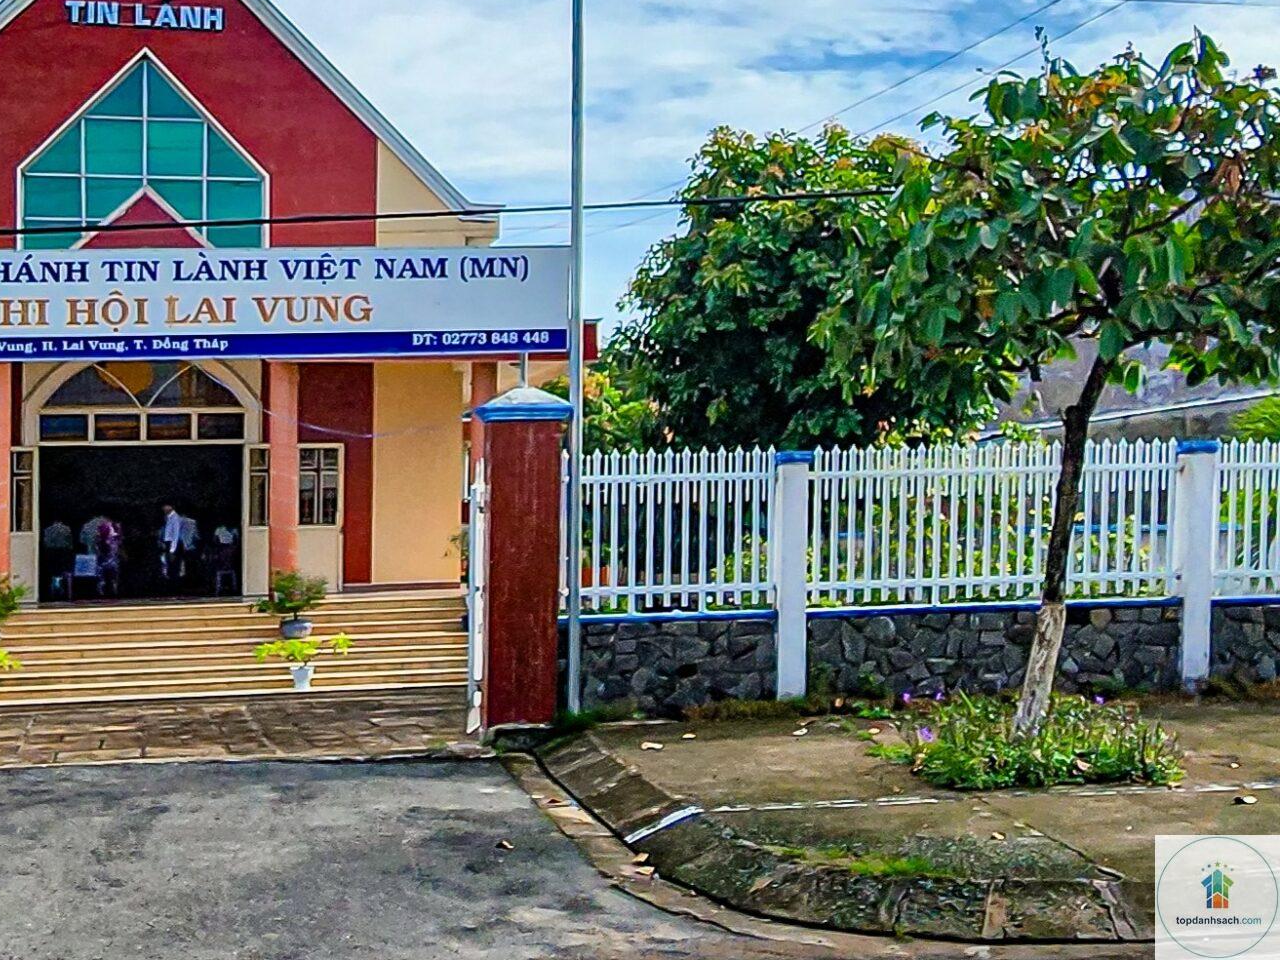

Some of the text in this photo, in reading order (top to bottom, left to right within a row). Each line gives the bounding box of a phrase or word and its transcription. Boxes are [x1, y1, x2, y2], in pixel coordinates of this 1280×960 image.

[65, 0, 119, 25] TIN
[100, 259, 161, 283] TIN
[172, 252, 266, 282] LÀNH
[279, 253, 361, 286] VIỆT
[374, 257, 449, 280] NAM
[459, 256, 530, 283] (MN)
[66, 290, 150, 332] HỘI
[164, 295, 237, 325] LAI
[252, 294, 374, 324] VUNG
[62, 340, 83, 351] Lai
[88, 340, 129, 353] Vung,
[133, 339, 147, 350] T.
[152, 336, 189, 352] Đồng
[193, 338, 228, 351] Tháp
[412, 331, 550, 345] ĐT: 02773 848 448
